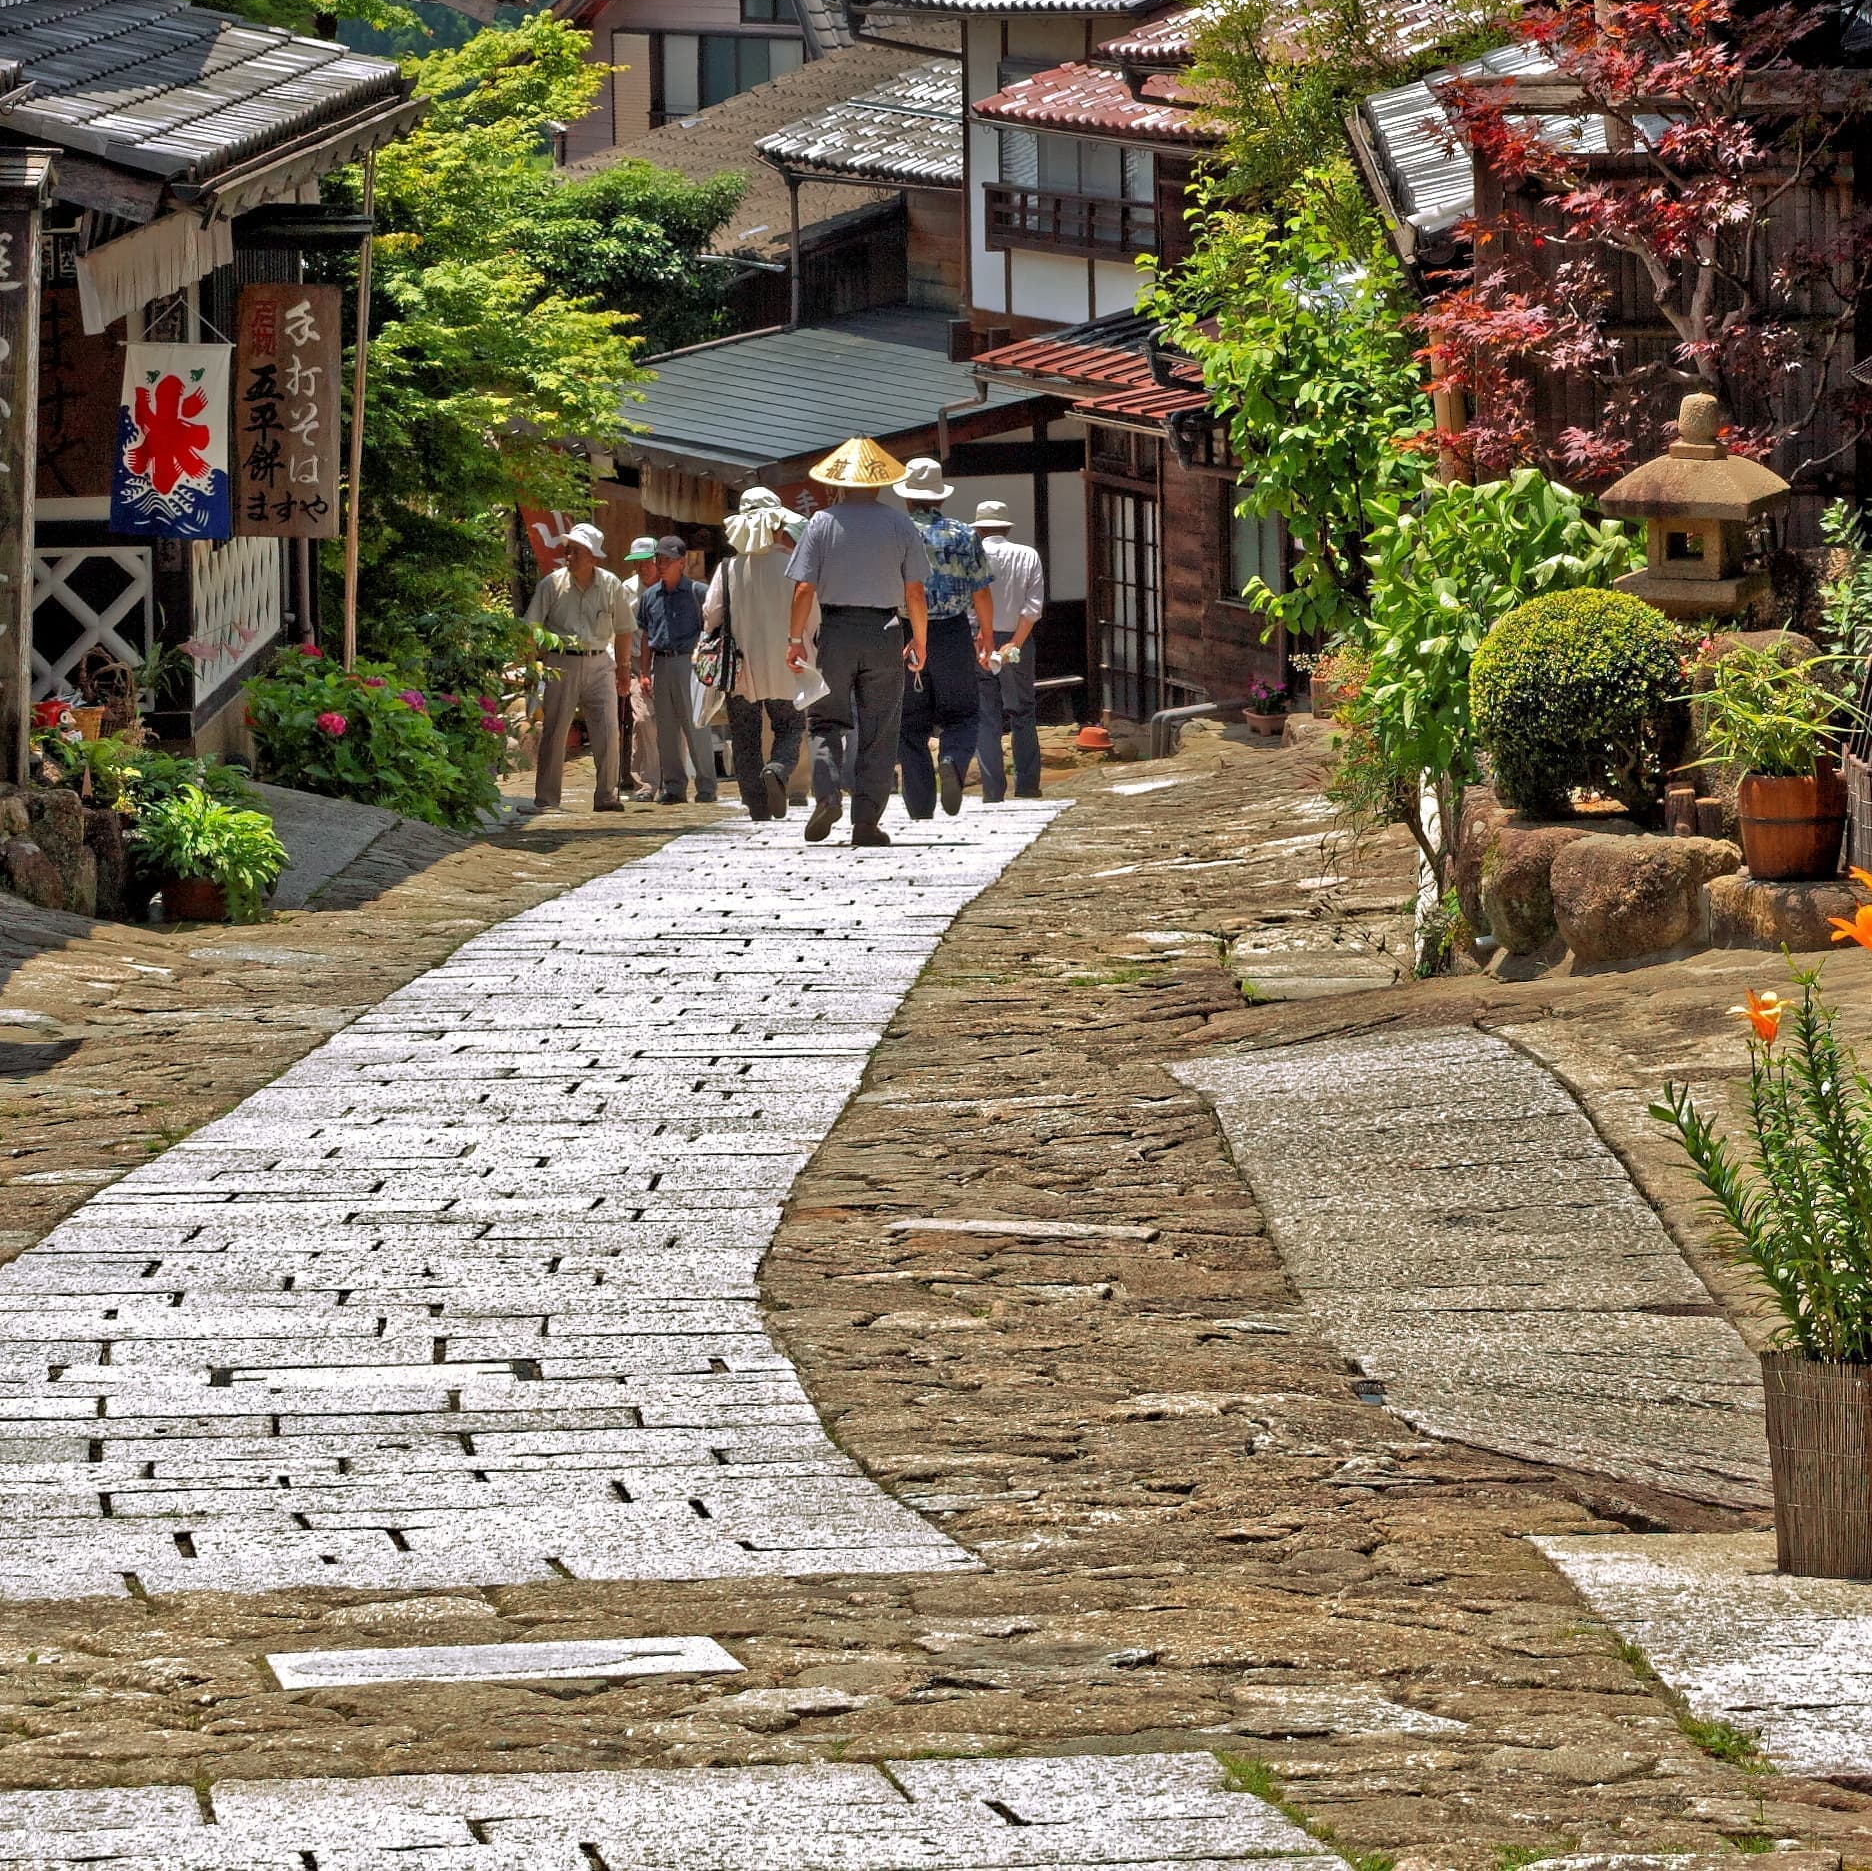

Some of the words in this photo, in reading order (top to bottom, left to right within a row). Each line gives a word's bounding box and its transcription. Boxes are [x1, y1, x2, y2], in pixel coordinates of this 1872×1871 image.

[243, 363, 286, 489] 五平餅
[247, 490, 329, 524] ますや
